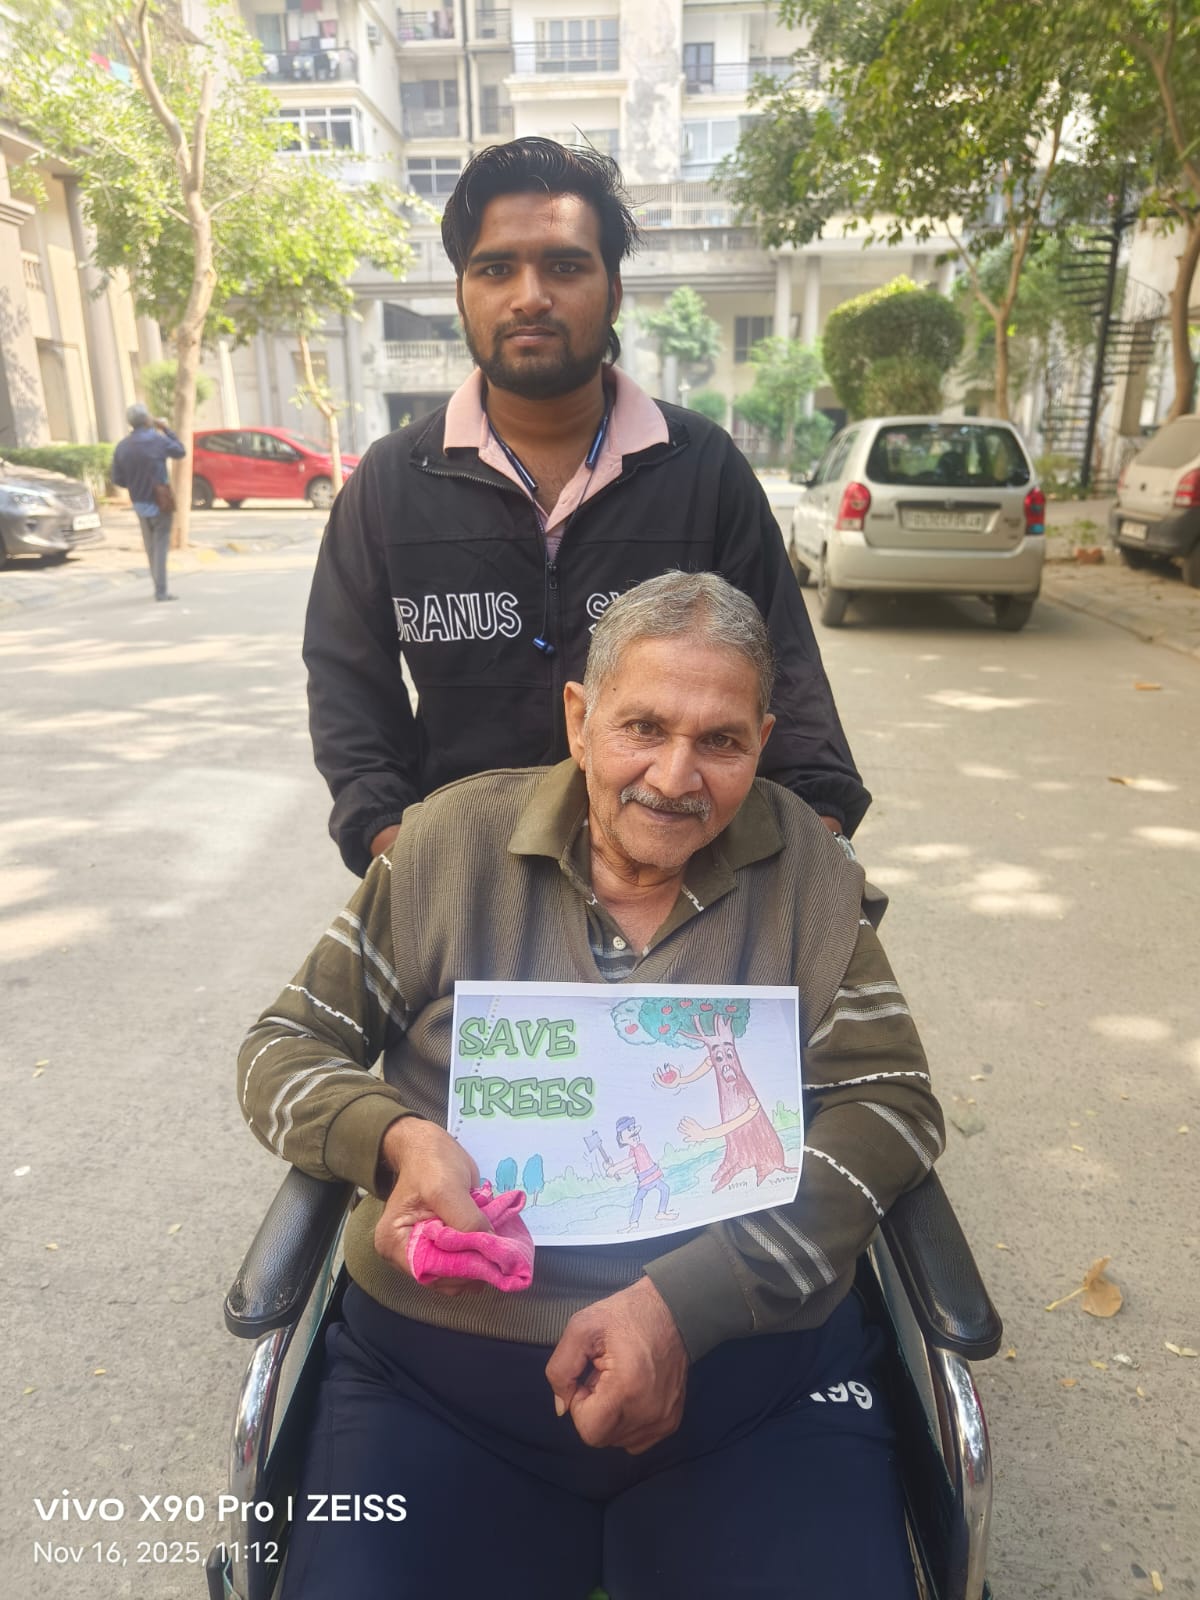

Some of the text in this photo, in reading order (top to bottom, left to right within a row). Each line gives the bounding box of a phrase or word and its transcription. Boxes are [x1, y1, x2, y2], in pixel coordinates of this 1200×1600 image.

[586, 591, 621, 636] S
[458, 1017, 577, 1059] SAVE
[454, 1075, 595, 1120] TREES
